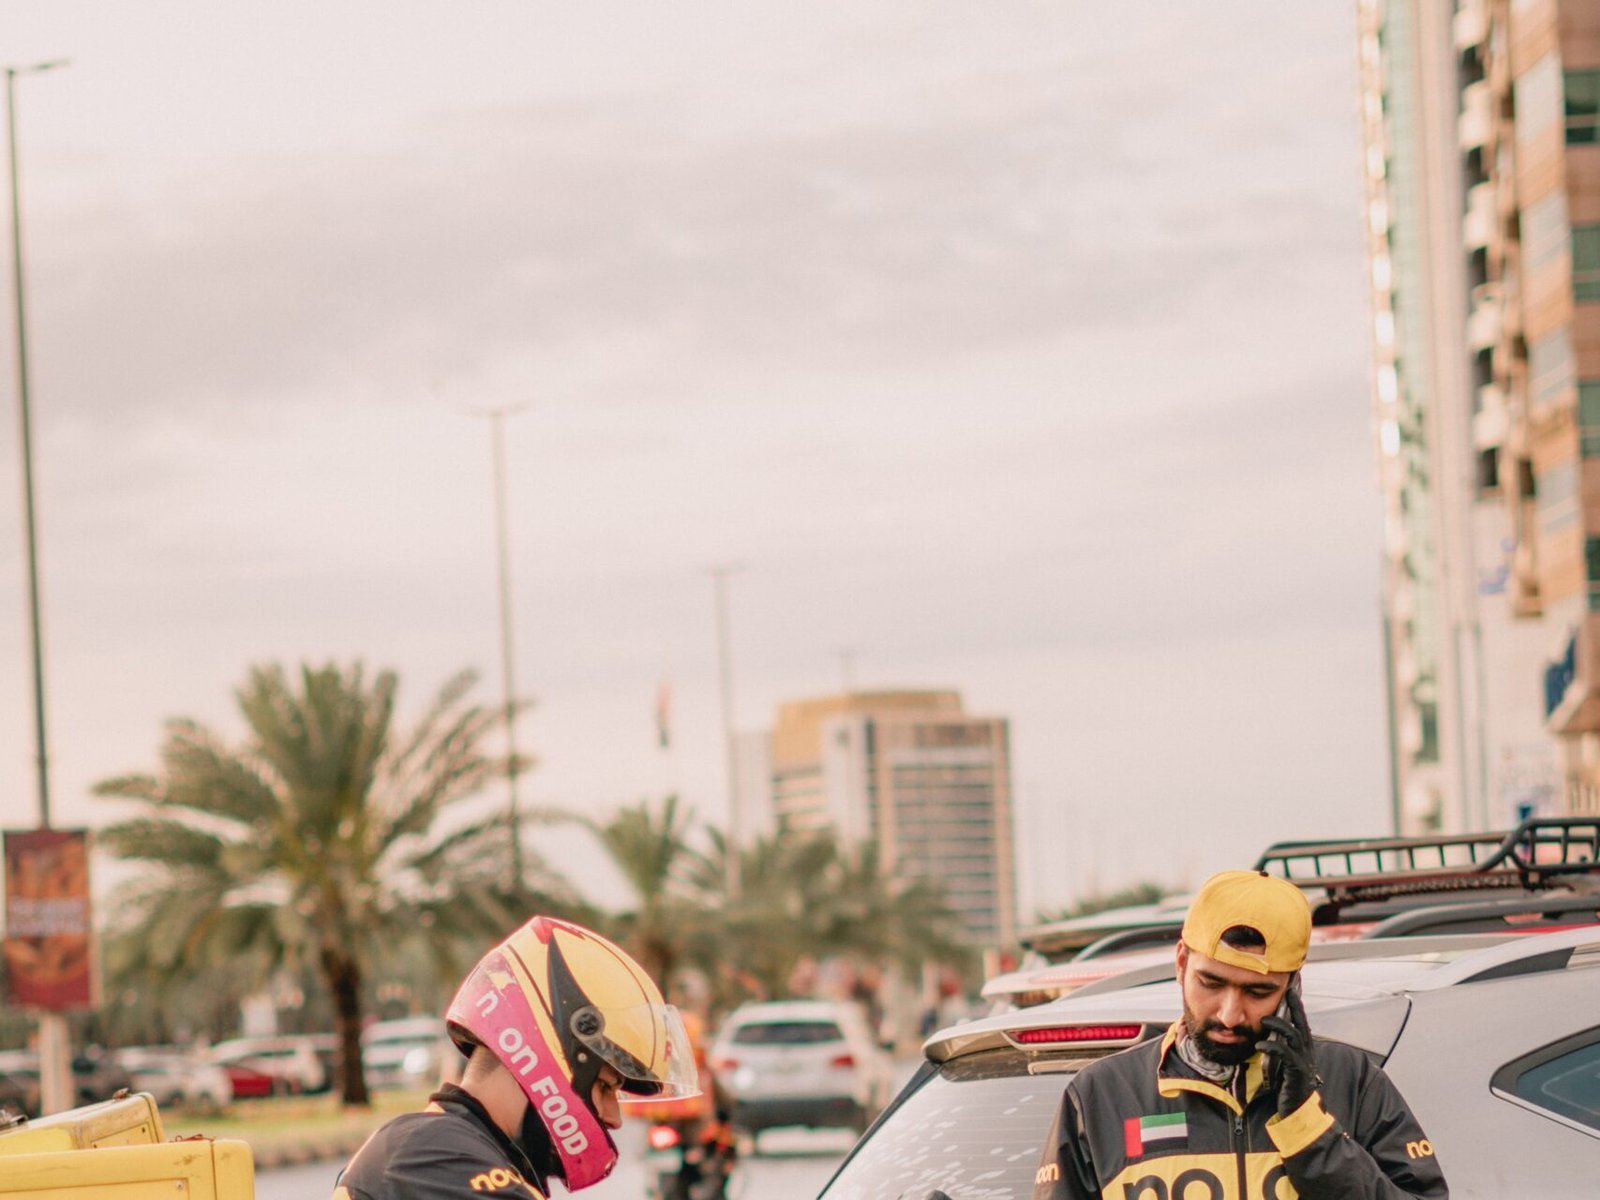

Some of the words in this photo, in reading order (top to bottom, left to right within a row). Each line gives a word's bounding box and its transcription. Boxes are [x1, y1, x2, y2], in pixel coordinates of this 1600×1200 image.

[530, 1076, 588, 1155] FOOD
[1406, 1139, 1434, 1159] no
[470, 1168, 521, 1192] no
[1035, 1162, 1060, 1184] oon
